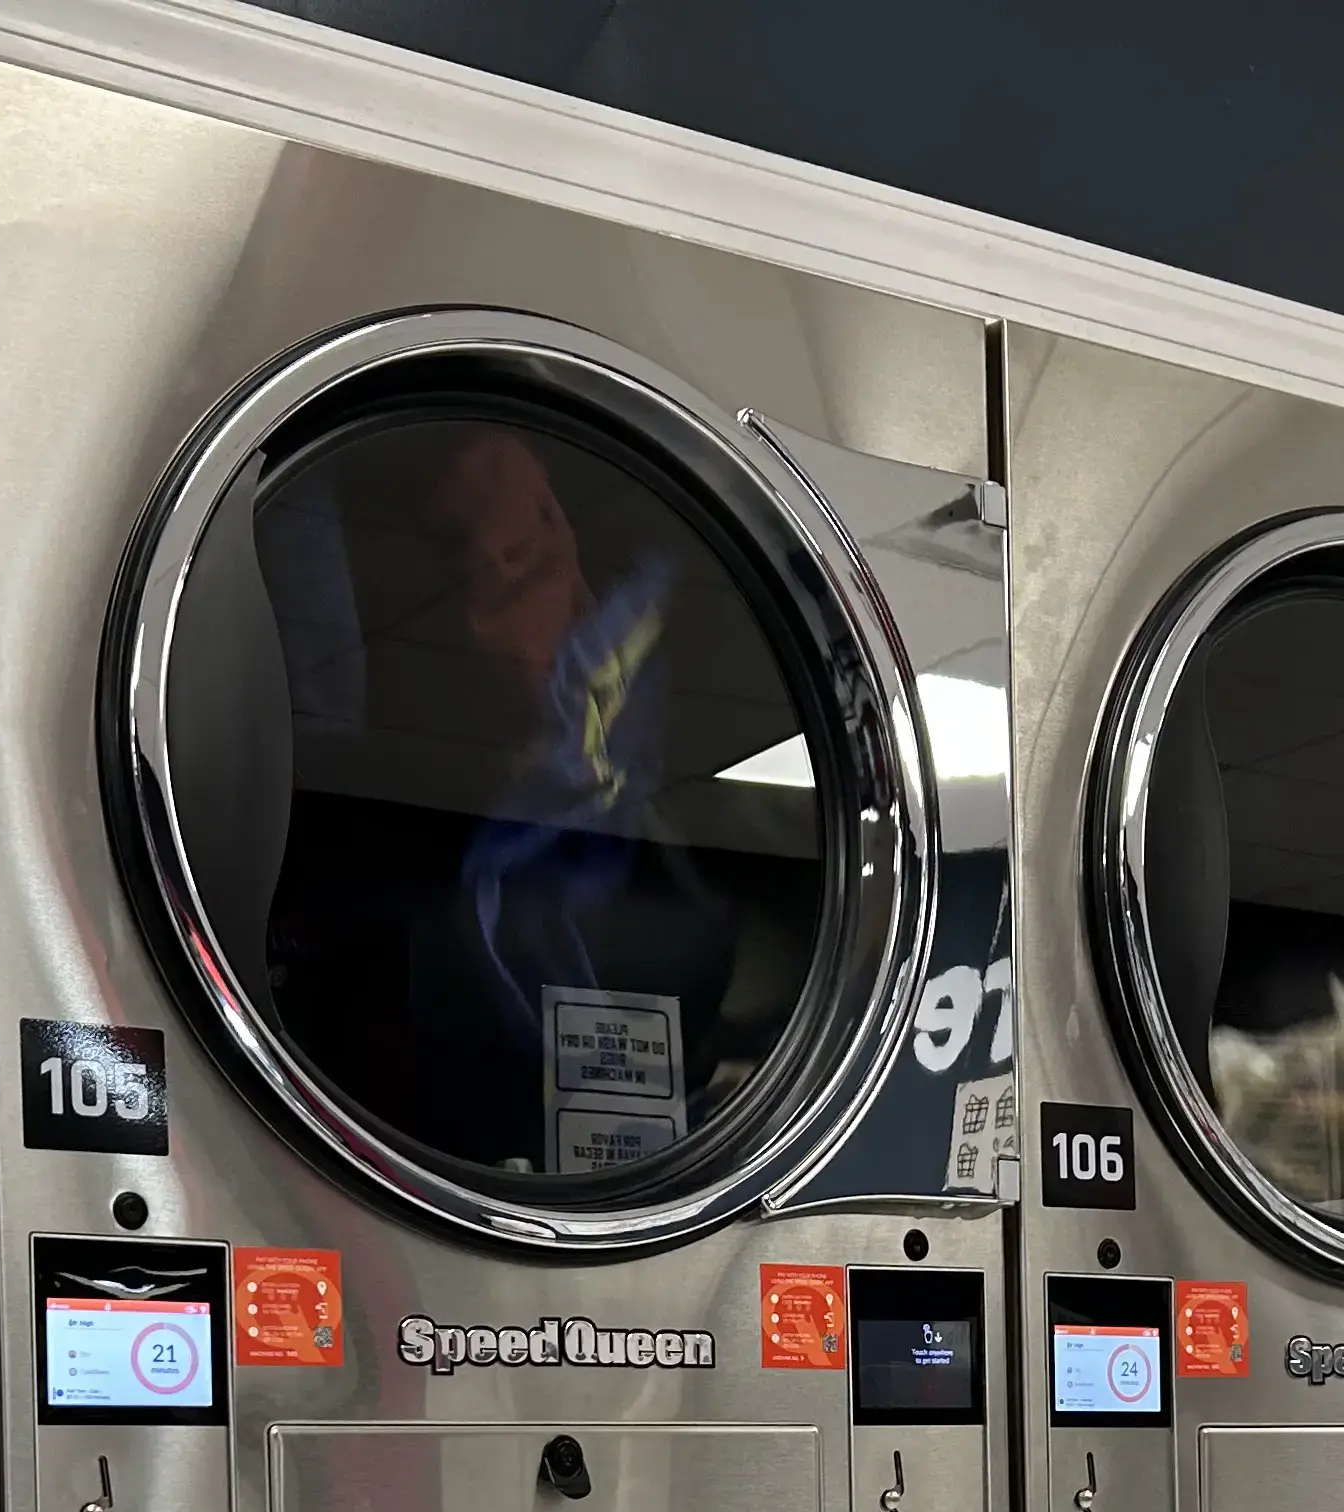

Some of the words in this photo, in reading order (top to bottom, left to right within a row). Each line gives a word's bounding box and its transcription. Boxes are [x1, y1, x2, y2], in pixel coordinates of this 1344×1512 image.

[40, 1057, 149, 1120] 105
[1052, 1132, 1124, 1182] 106
[152, 1344, 177, 1363] 21
[398, 1315, 562, 1375] Speed
[562, 1316, 716, 1369] Queen
[1121, 1361, 1138, 1377] 24
